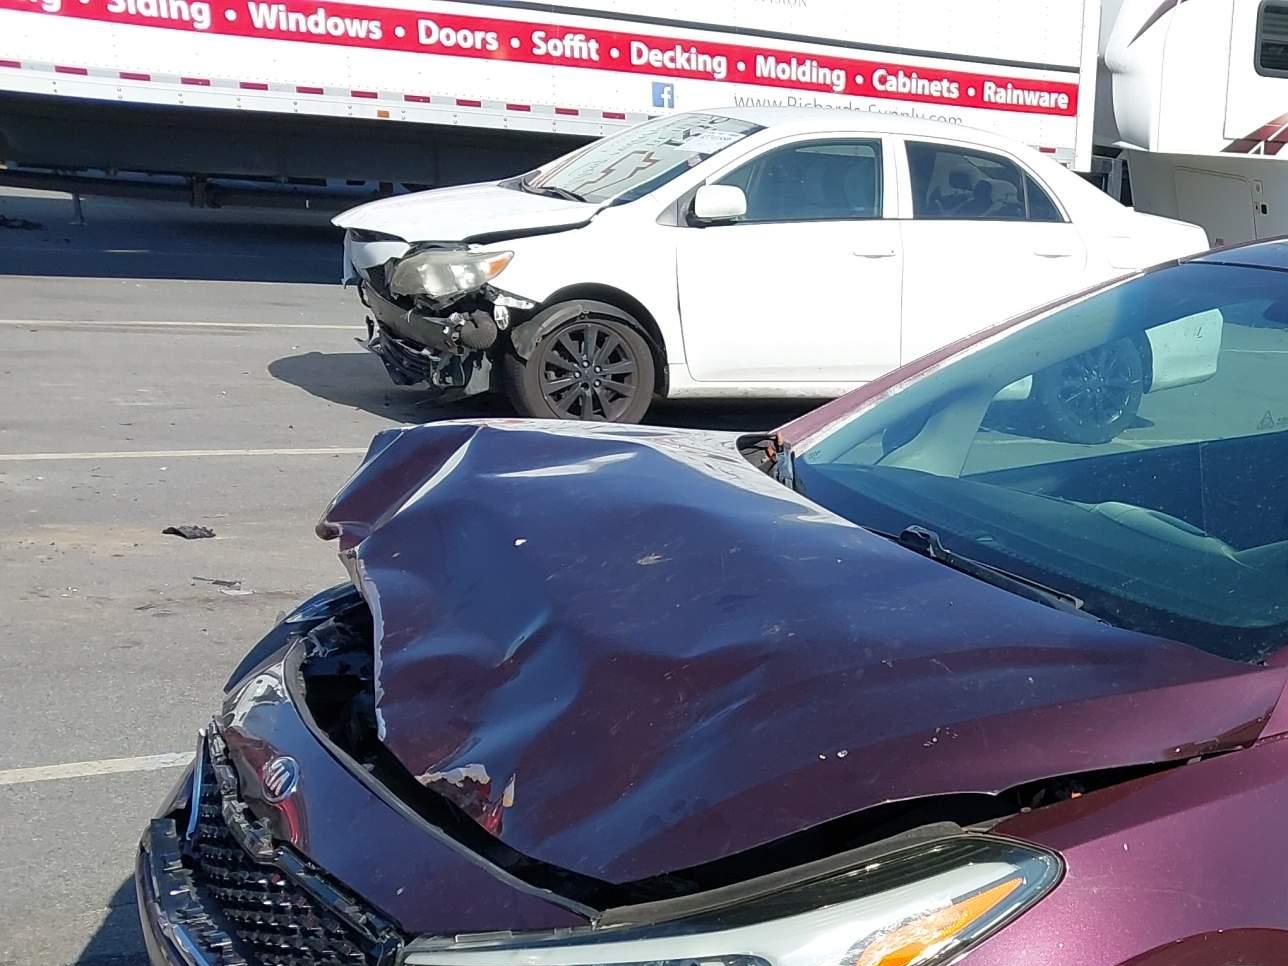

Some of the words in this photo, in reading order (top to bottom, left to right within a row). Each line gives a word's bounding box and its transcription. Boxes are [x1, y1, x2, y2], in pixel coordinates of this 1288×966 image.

[248, 2, 383, 40] Windows
[417, 19, 499, 50] Doors
[531, 31, 600, 61] Soffit
[630, 41, 728, 79] Decking
[755, 55, 846, 91] Molding
[872, 69, 960, 99] Cabinets
[983, 81, 1069, 109] Rainware
